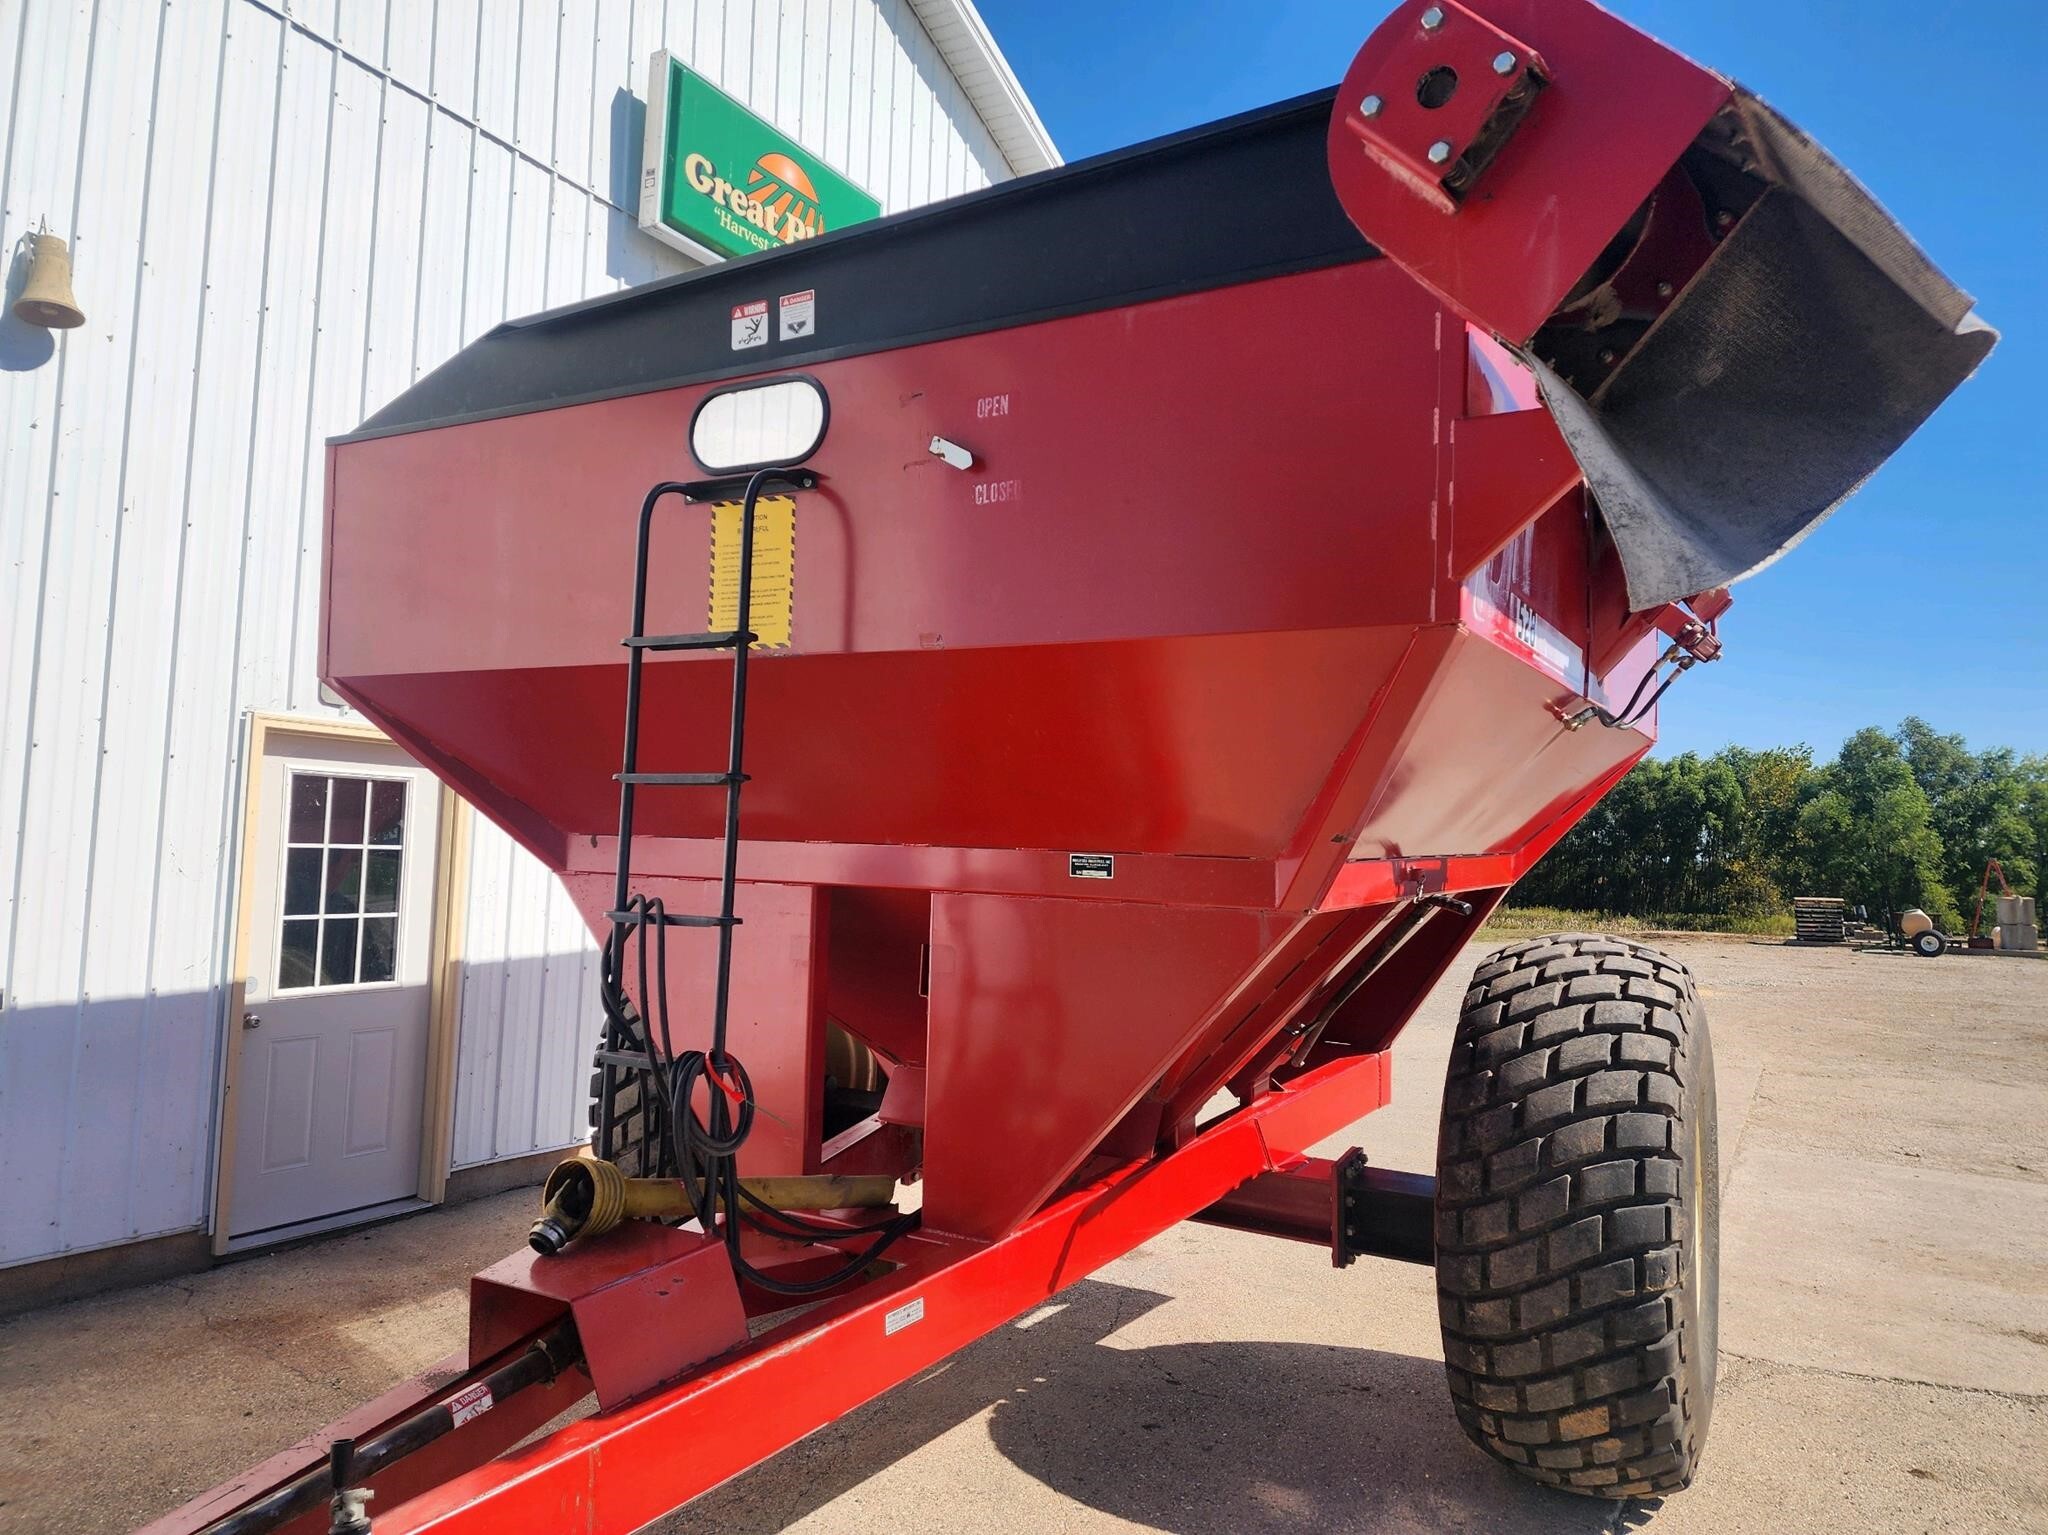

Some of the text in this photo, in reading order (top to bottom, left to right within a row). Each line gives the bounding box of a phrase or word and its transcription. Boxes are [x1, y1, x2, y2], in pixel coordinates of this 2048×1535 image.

[685, 153, 779, 236] Great
[977, 394, 1009, 418] OPEN
[459, 1386, 488, 1405] DANGER
